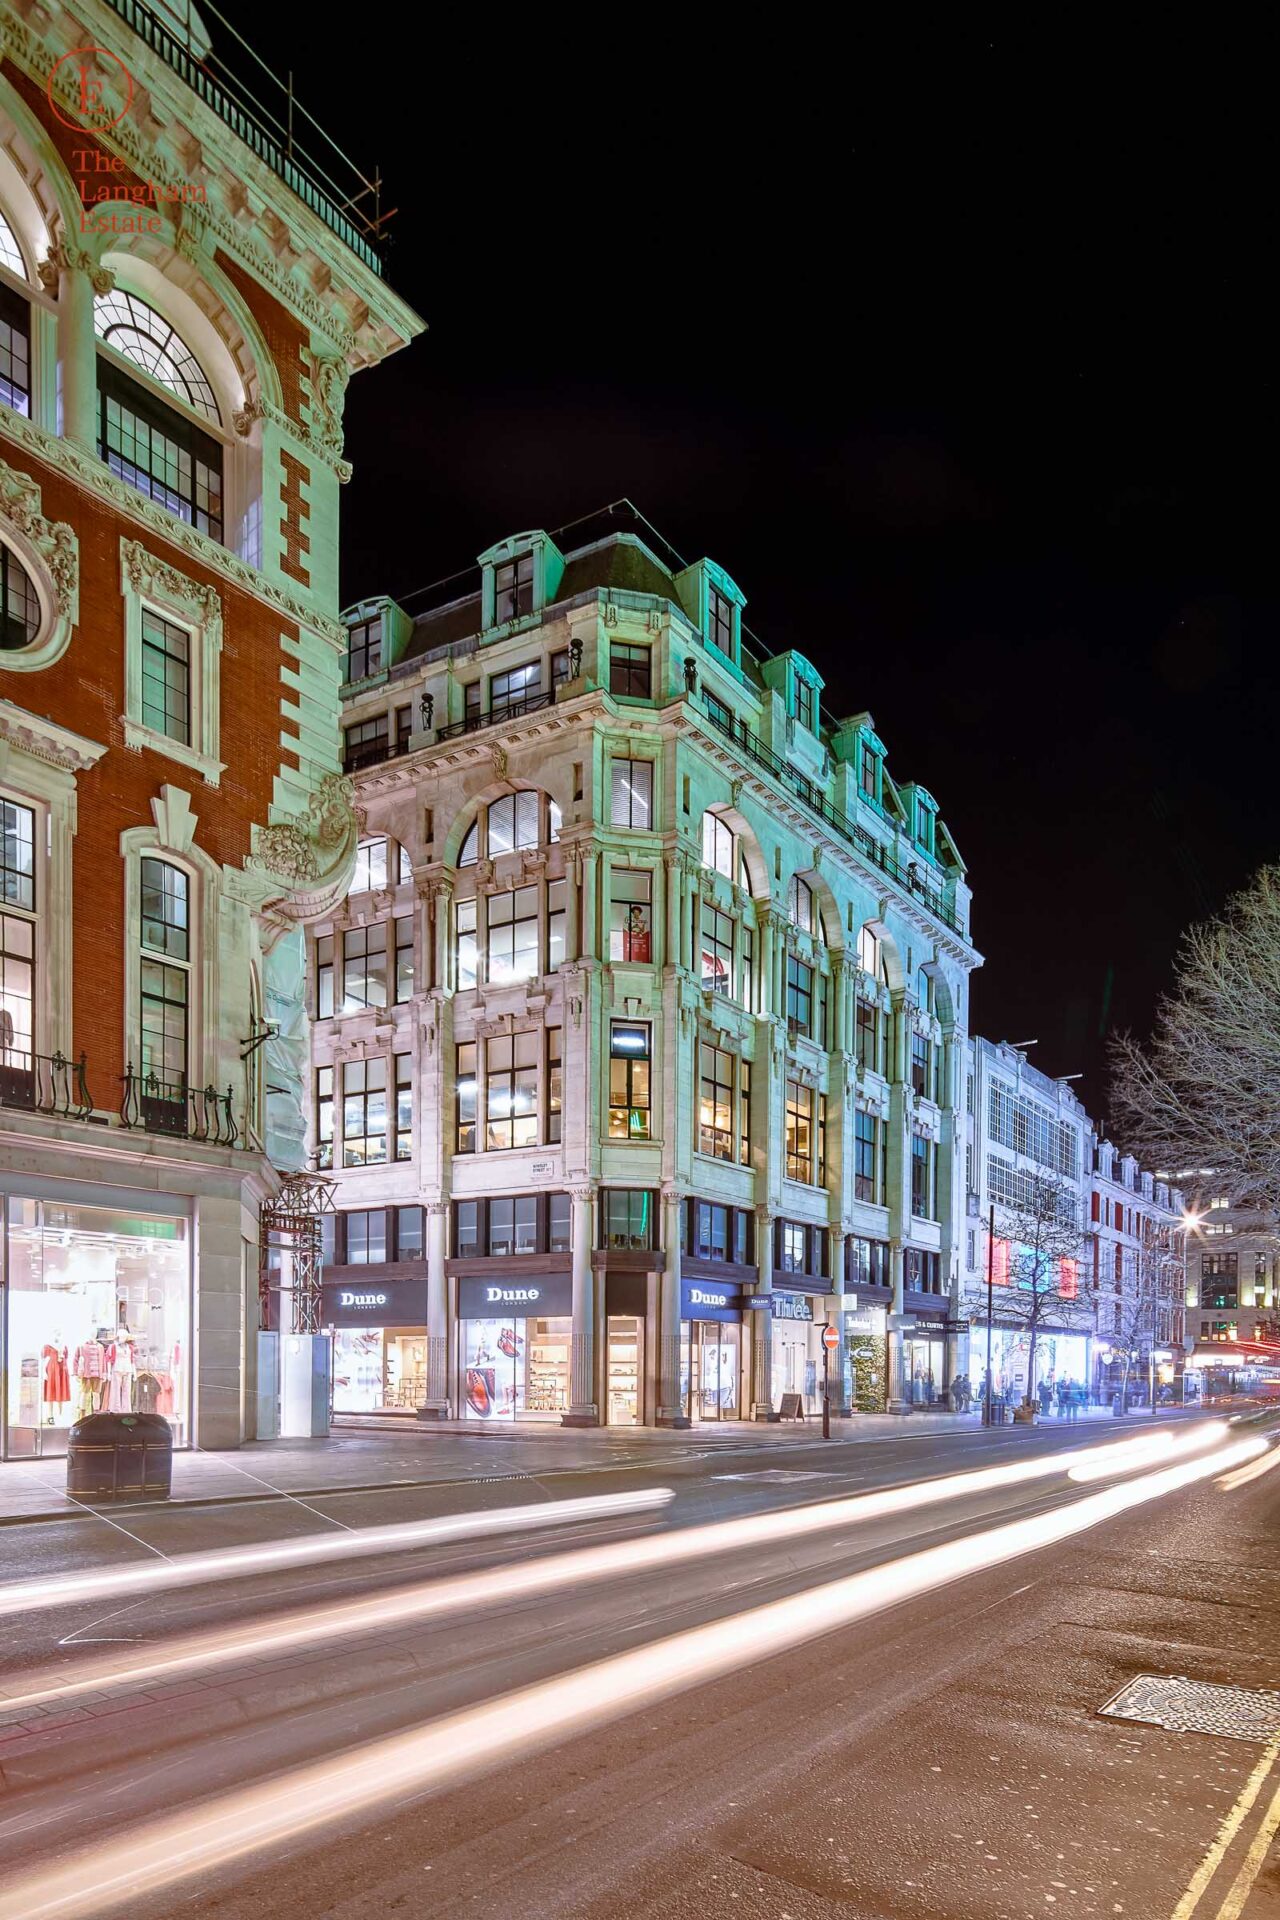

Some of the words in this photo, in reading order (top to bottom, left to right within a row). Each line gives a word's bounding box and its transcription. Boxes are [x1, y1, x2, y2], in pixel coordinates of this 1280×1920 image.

[340, 1292, 387, 1306] Dune
[486, 1287, 540, 1302] Dune
[690, 1289, 727, 1306] Dune
